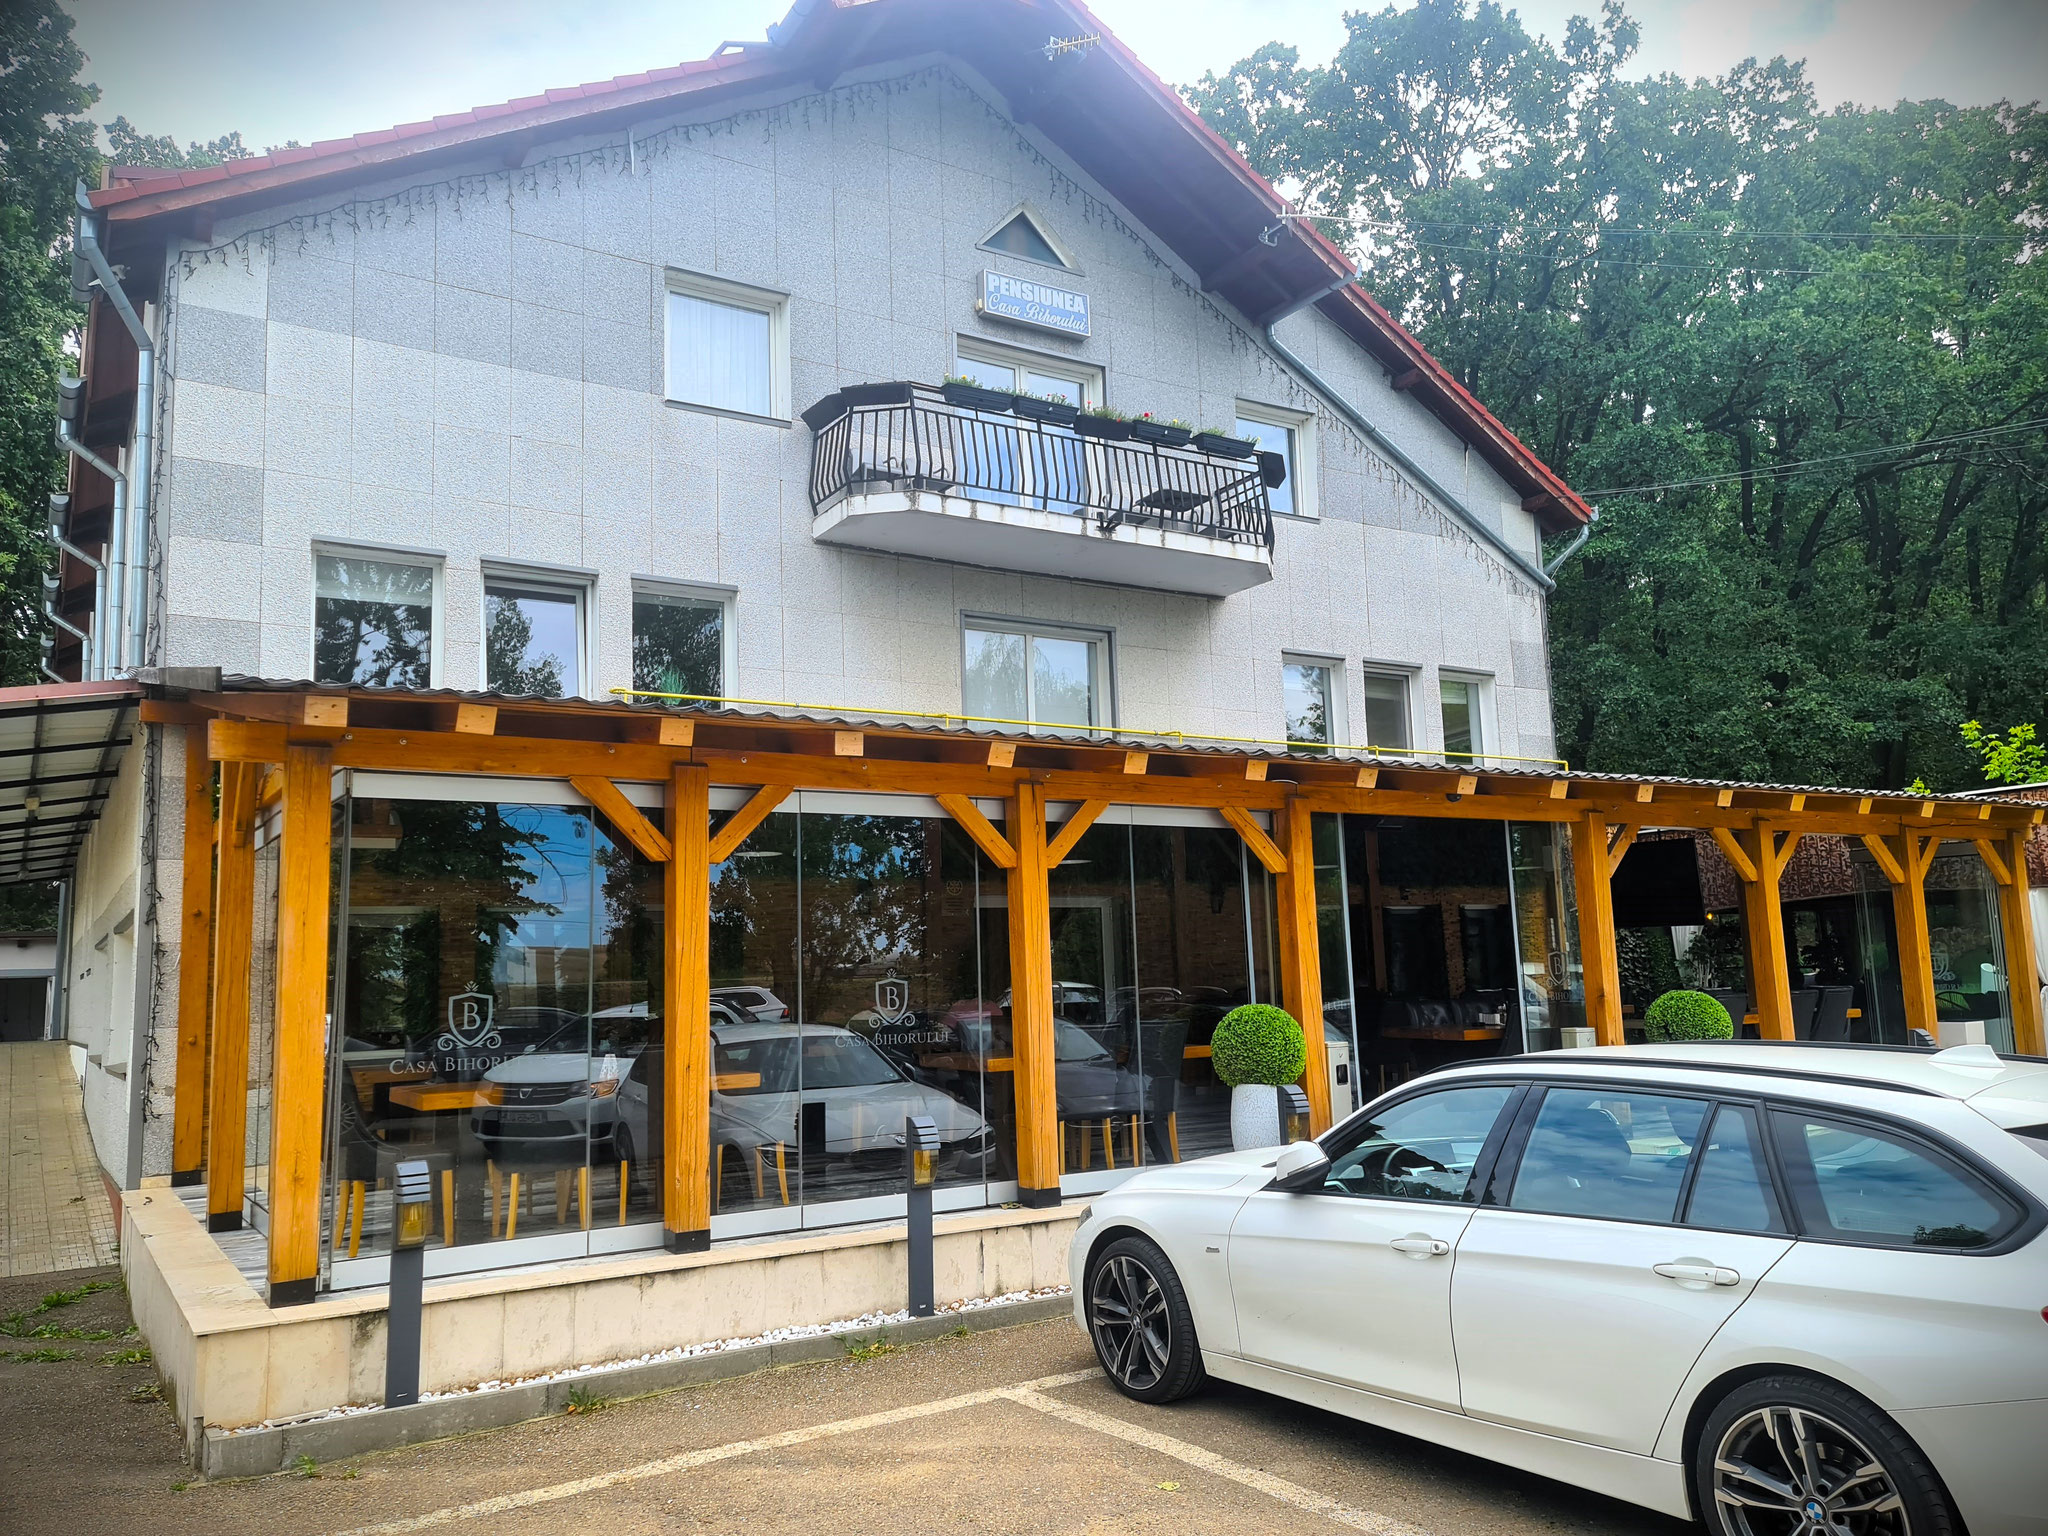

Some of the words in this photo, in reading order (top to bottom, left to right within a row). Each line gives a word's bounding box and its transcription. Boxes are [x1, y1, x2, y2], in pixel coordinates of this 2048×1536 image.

[987, 273, 1086, 314] PENSIUNEA
[988, 293, 1020, 315] Casa
[1024, 302, 1087, 331] Bihorului
[886, 986, 900, 1010] B
[461, 1001, 481, 1030] B
[875, 1031, 950, 1046] BIHORULUI
[389, 1058, 438, 1075] CASA
